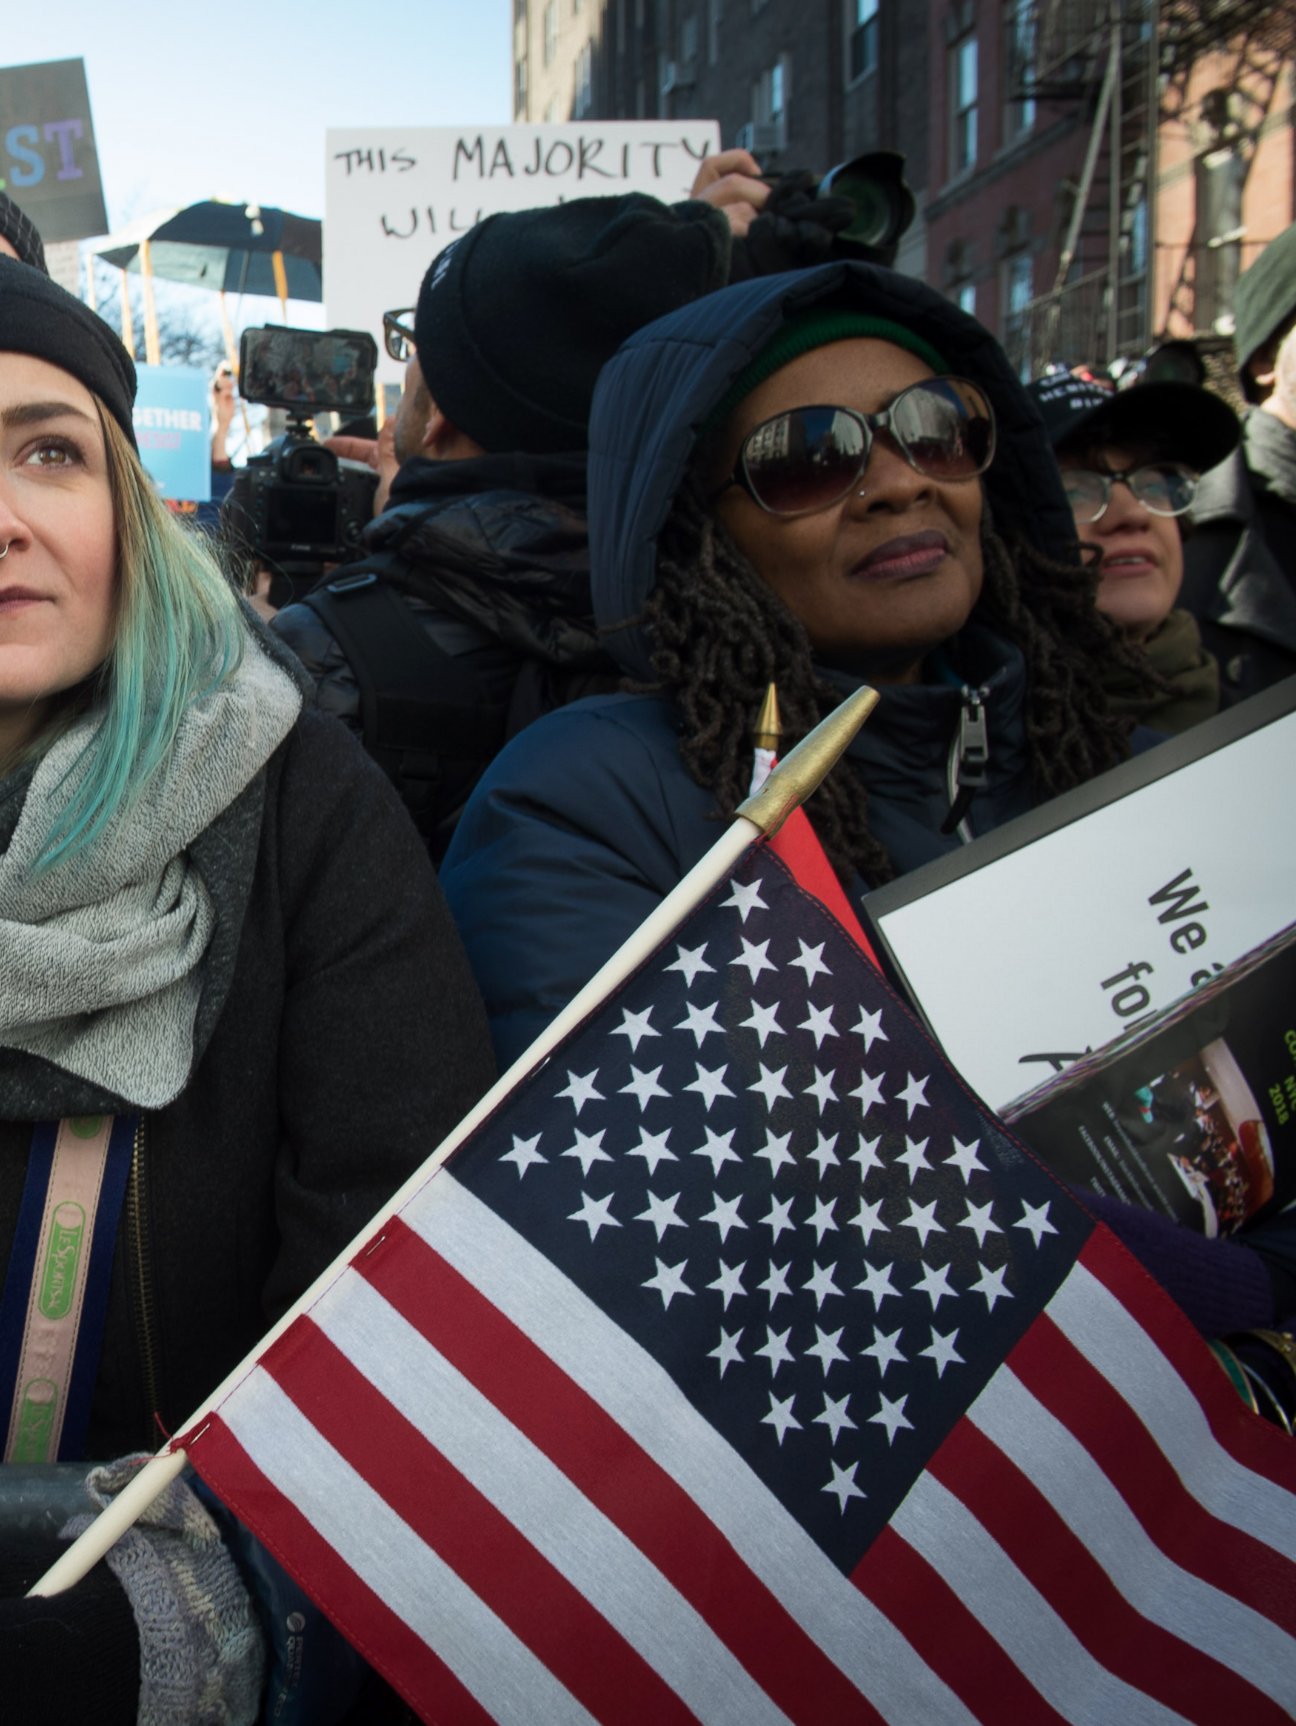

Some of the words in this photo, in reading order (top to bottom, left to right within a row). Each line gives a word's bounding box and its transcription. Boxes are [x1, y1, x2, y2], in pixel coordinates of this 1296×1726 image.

[334, 146, 418, 176] THIS
[452, 134, 712, 181] MAJORITY
[1147, 867, 1210, 955] We
[1100, 961, 1158, 1031] fo
[1268, 1082, 1289, 1125] 2018
